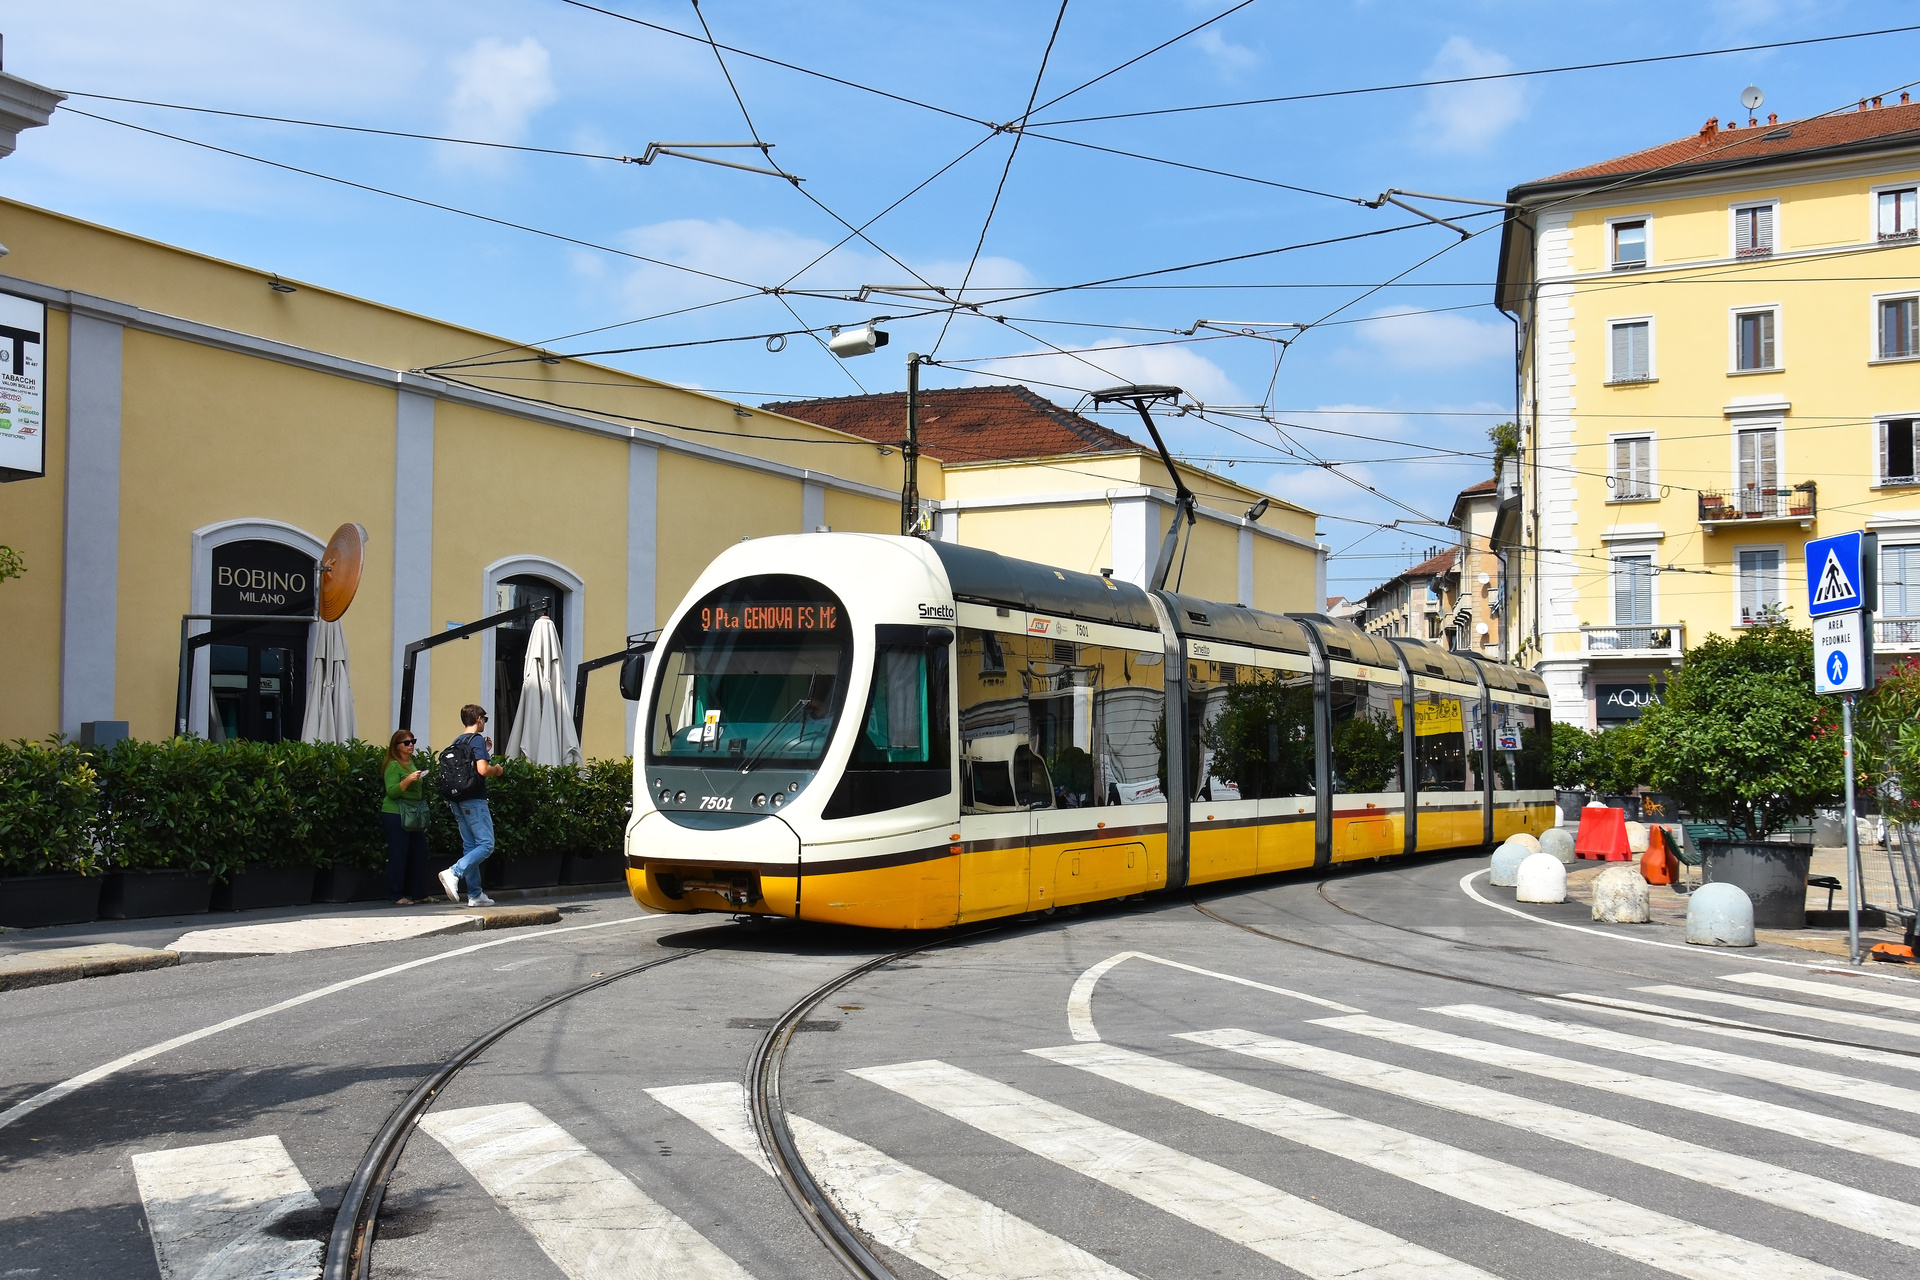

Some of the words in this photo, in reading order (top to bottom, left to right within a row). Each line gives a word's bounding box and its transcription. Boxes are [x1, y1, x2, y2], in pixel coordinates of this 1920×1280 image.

[0, 324, 40, 376] T
[2, 373, 36, 386] TABACCHI
[218, 566, 306, 593] BOBINO
[239, 591, 285, 605] MILANO
[701, 608, 711, 629] 9
[715, 607, 739, 630] Pta
[744, 606, 793, 629] GENOVA
[798, 606, 815, 629] FS
[1828, 619, 1844, 630] AREA
[1075, 623, 1089, 637] 7501
[1822, 633, 1851, 647] PEDONALE
[1607, 688, 1661, 707] AQUA
[706, 725, 712, 735] 9
[699, 796, 733, 811] 7501
